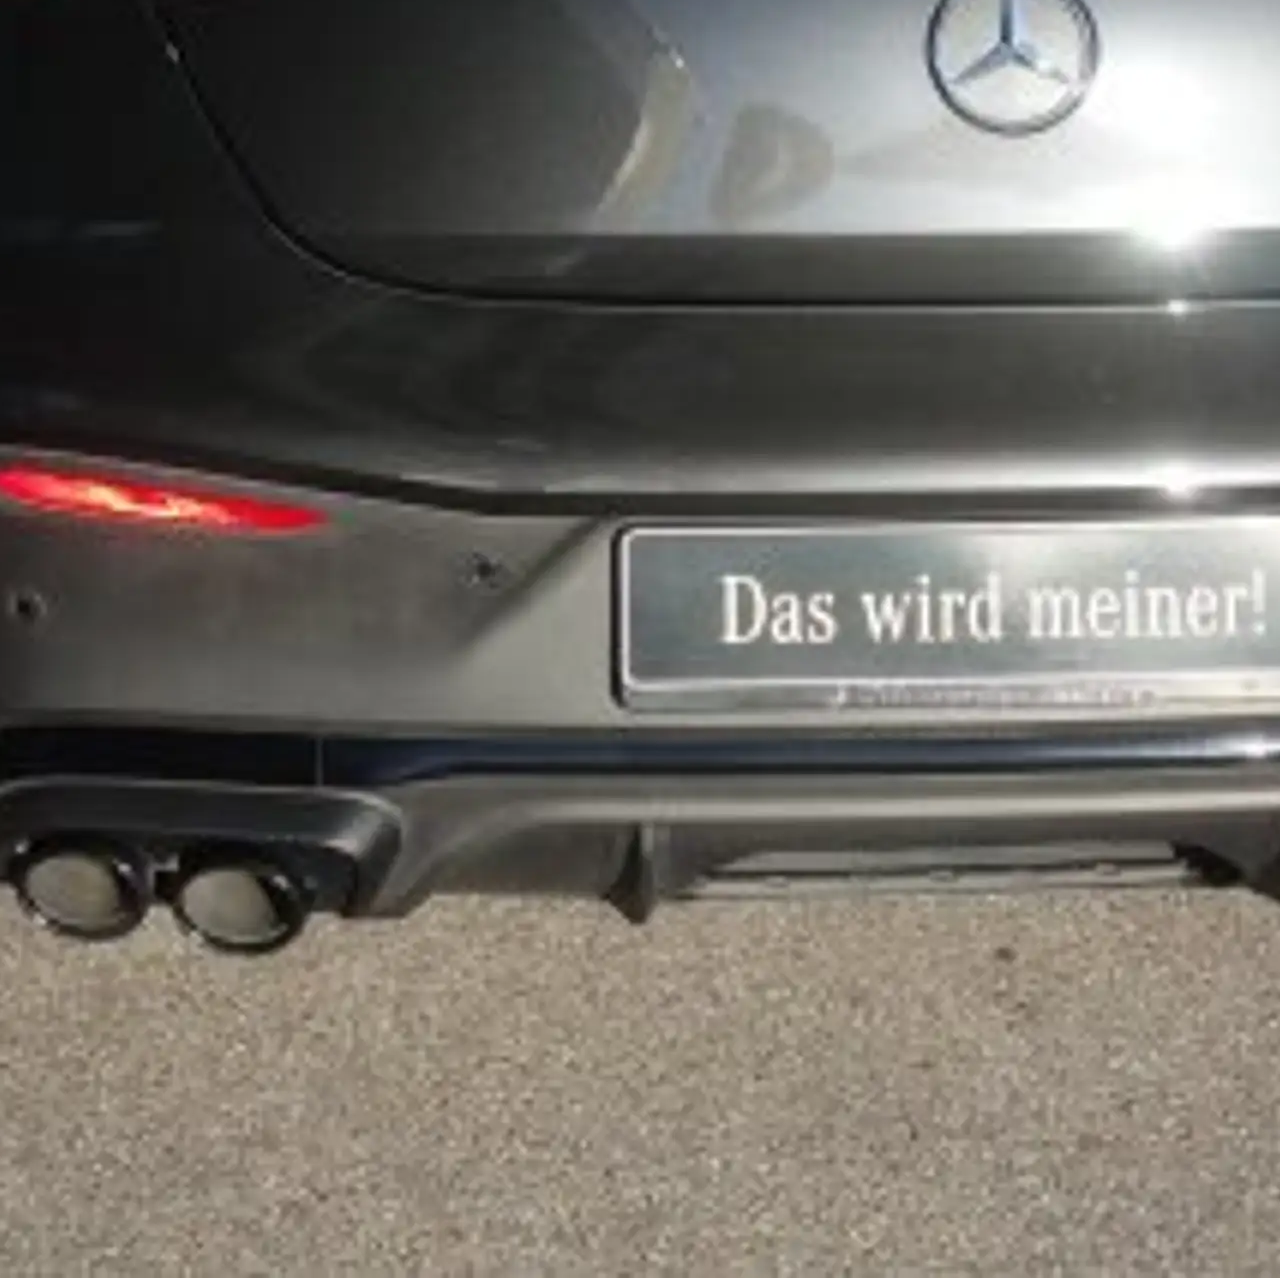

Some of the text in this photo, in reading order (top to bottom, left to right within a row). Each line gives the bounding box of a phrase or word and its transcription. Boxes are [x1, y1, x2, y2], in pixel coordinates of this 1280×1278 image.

[719, 567, 1268, 644] Das wird meiner!
